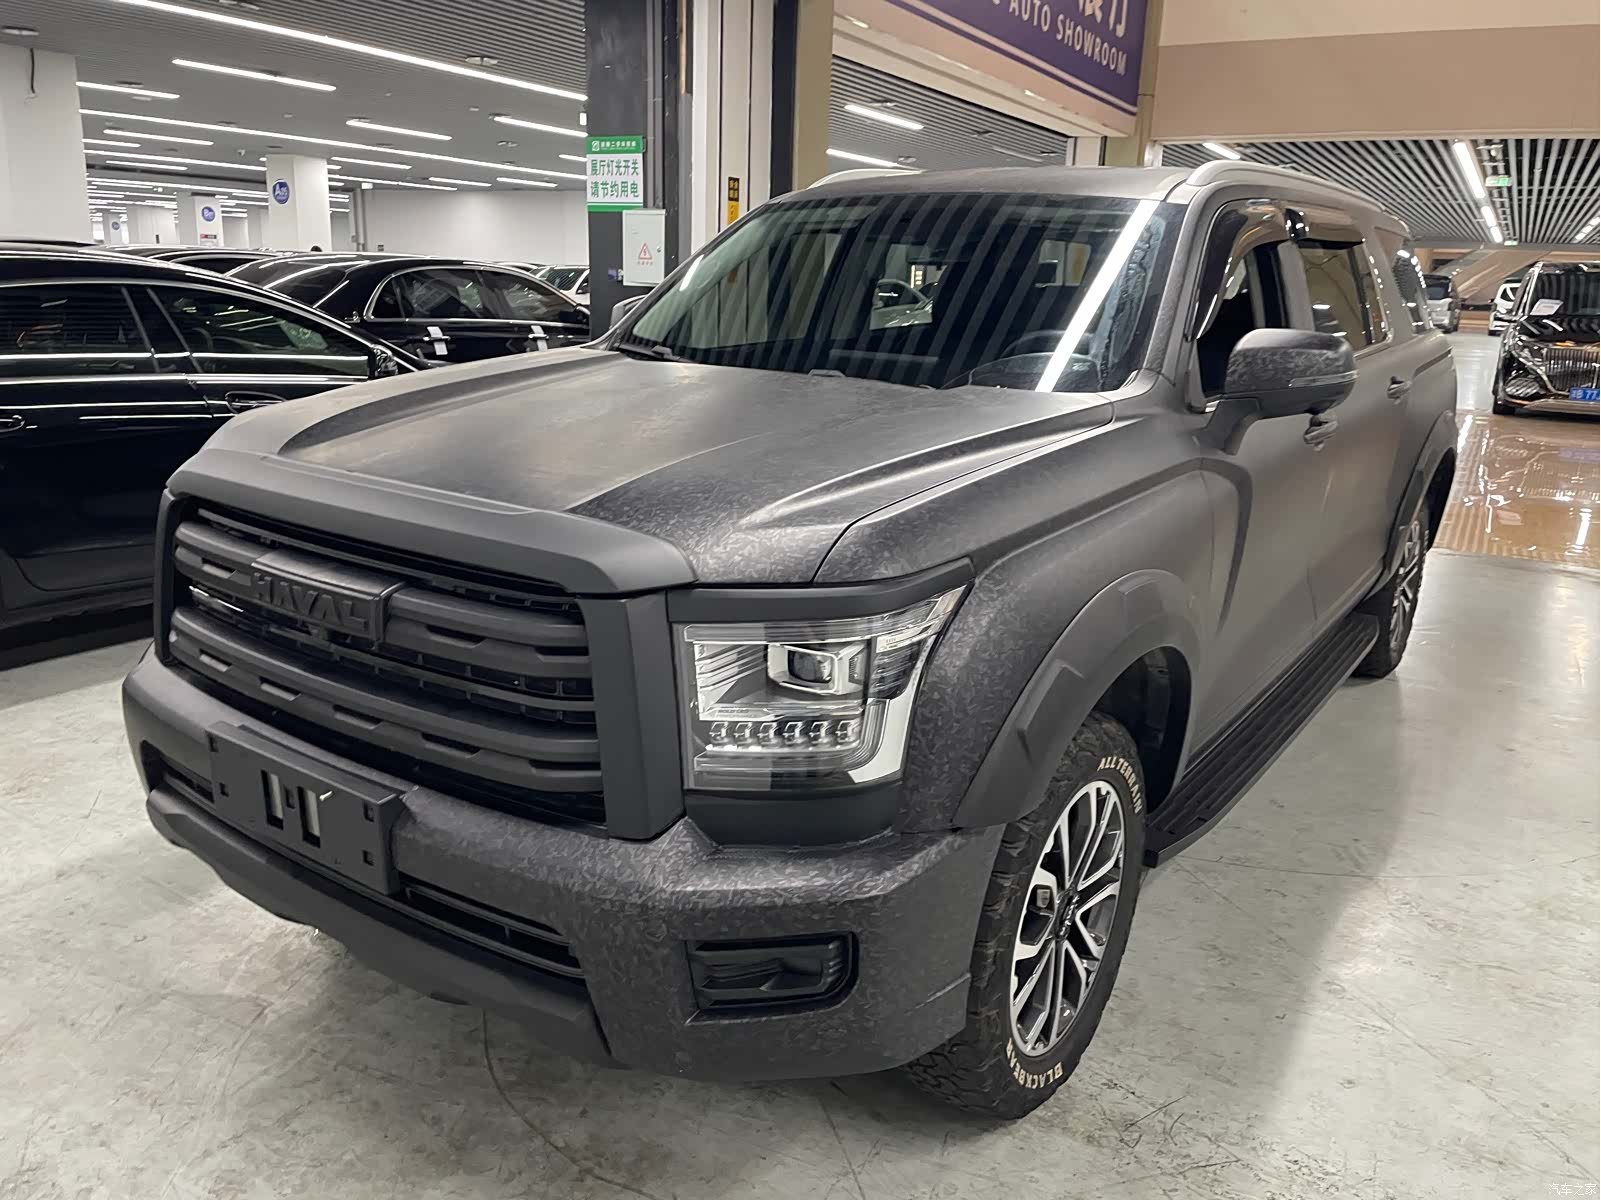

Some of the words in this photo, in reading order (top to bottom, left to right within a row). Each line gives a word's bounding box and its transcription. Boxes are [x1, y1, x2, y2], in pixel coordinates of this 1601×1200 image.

[1009, 0, 1051, 32] AUTO
[1056, 14, 1127, 76] SHOWROOM
[590, 181, 638, 198] 请节约用电
[591, 159, 638, 176] 展厅灯光开关
[253, 572, 367, 634] HAVAL
[1097, 756, 1117, 771] ALL
[1116, 758, 1142, 813] TERRAIN
[1006, 1038, 1063, 1089] BLACKBEAR
